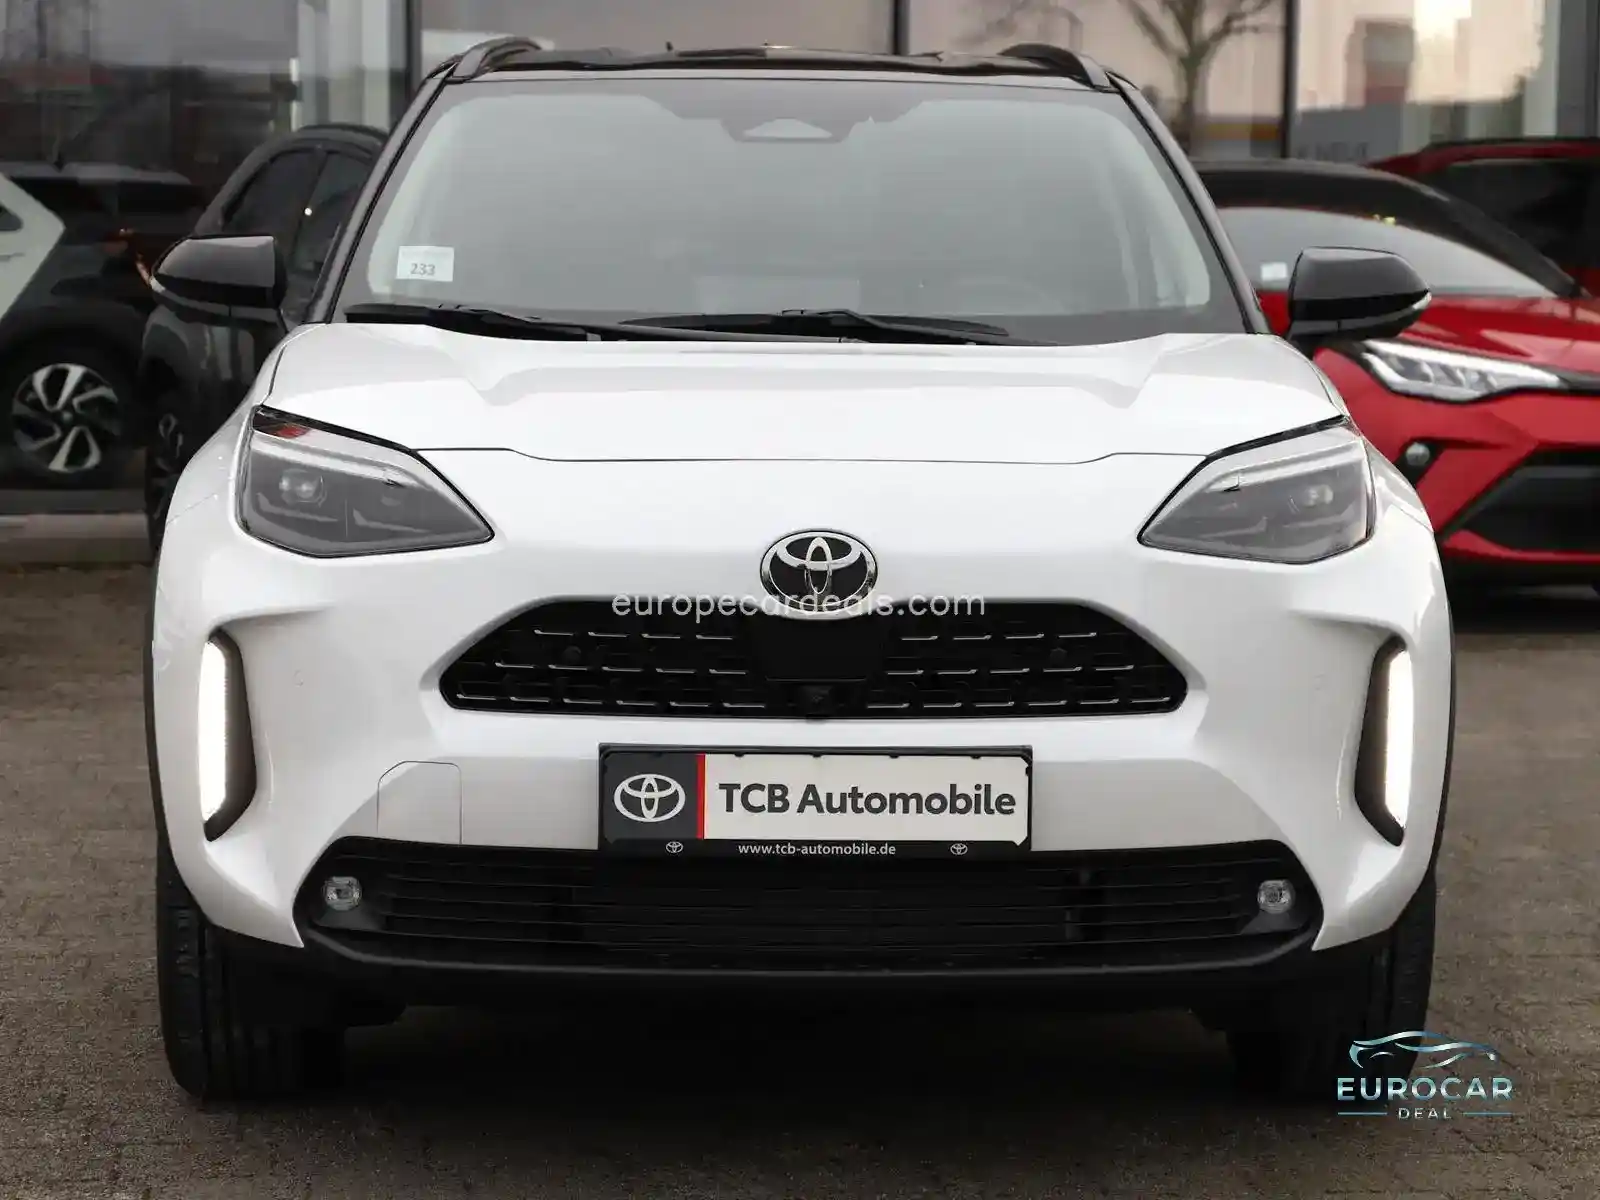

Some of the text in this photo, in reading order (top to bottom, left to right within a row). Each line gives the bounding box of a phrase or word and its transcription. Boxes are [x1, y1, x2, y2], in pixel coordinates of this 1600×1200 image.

[410, 262, 436, 276] 233
[719, 783, 1016, 816] TCB Automobile
[738, 842, 896, 856] www.tcb-automobile.de
